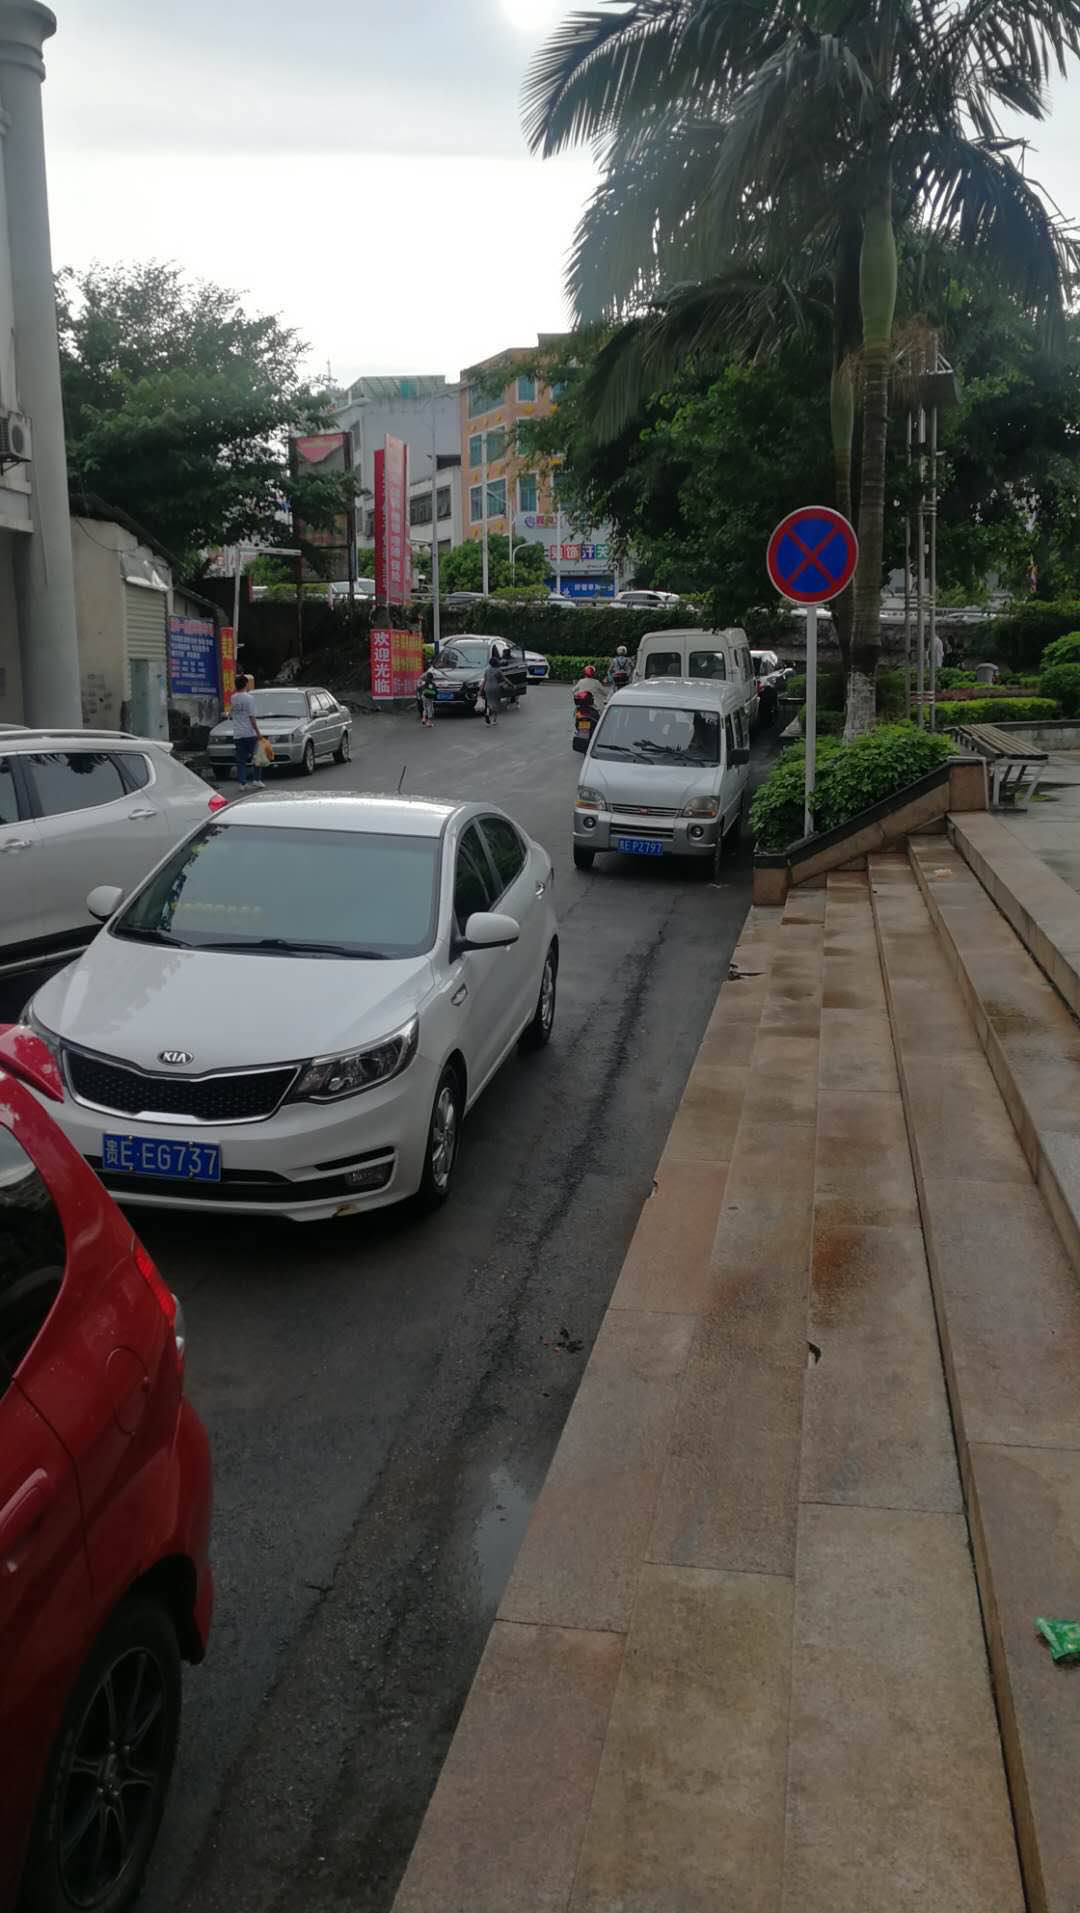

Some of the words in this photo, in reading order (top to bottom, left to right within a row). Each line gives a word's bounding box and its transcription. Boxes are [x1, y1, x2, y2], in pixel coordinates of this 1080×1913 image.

[374, 631, 390, 693] 欢迎光临
[162, 1051, 186, 1063] KIA
